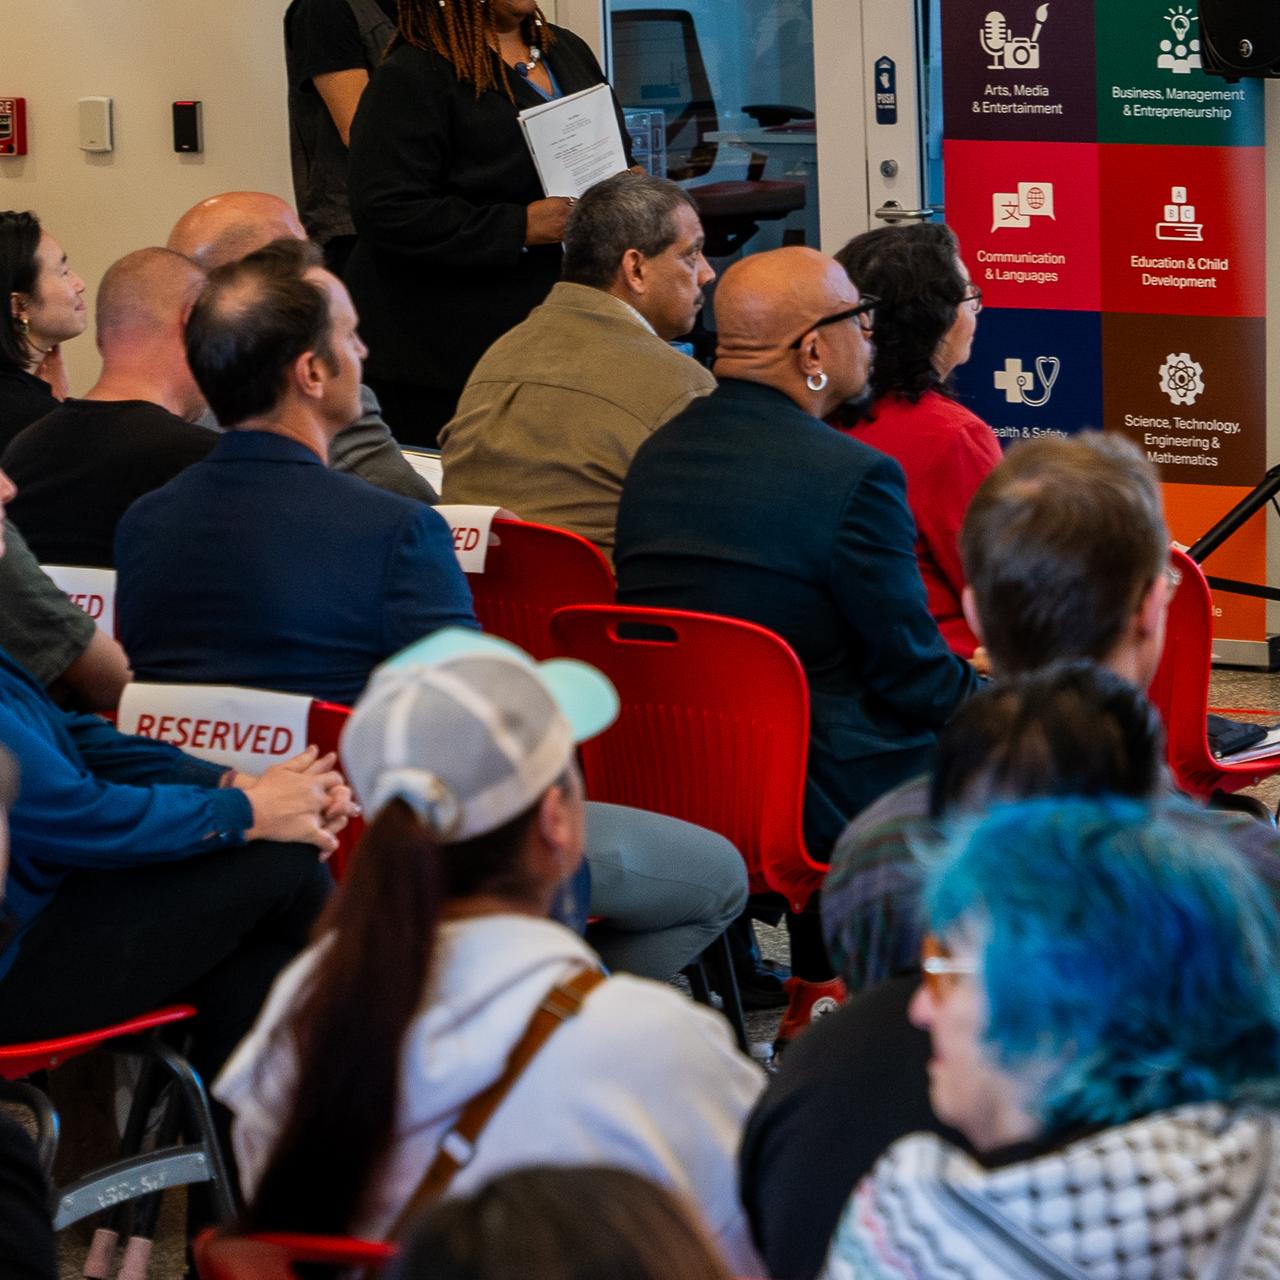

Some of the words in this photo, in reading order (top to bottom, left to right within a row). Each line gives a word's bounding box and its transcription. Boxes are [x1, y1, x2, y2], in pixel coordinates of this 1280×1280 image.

[984, 84, 1012, 97] Arts,
[1014, 84, 1049, 97] Media
[1112, 86, 1165, 100] Business,
[1166, 88, 1246, 102] Management
[0, 101, 12, 113] RE
[972, 103, 980, 113] &
[982, 102, 1063, 115] Entertainment
[1123, 105, 1132, 116] &
[1133, 104, 1232, 120] Entrepreneurship
[977, 250, 1066, 265] Communication
[1131, 255, 1185, 270] Education
[1186, 257, 1196, 269] &
[1197, 257, 1229, 271] Child
[985, 269, 994, 280] &
[996, 268, 1058, 284] Languages
[1142, 273, 1217, 289] Development
[1124, 414, 1172, 429] Science,
[1174, 416, 1241, 434] Technology,
[1022, 427, 1030, 438] &
[1031, 427, 1068, 440] Safety
[1144, 433, 1210, 451] Engineering
[1211, 438, 1221, 449] &
[1147, 451, 1218, 467] Mathematics
[135, 714, 292, 756] RESERVED
